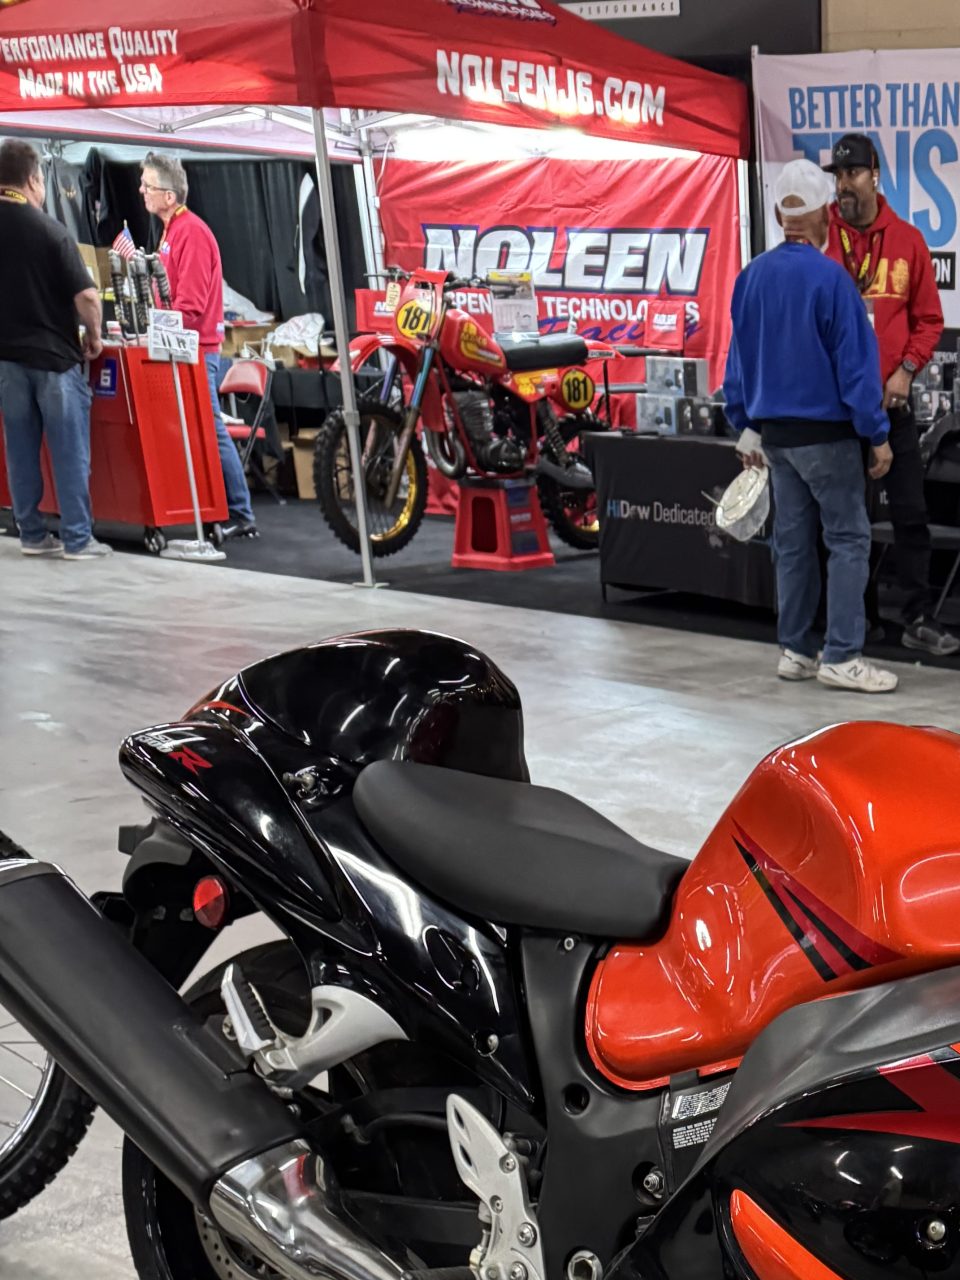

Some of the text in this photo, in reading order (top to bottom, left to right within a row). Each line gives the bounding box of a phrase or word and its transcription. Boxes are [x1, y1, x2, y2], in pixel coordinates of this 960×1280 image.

[0, 32, 107, 63] ERFORMANCE
[121, 62, 163, 94] USA
[436, 49, 665, 126] NOLEENJ6.COM
[788, 82, 960, 130] BETTER THAN
[793, 128, 958, 248] TNS
[420, 223, 710, 295] NOLEEN
[402, 306, 430, 331] 181
[543, 296, 699, 324] TECHNOLOS
[564, 376, 588, 403] 181
